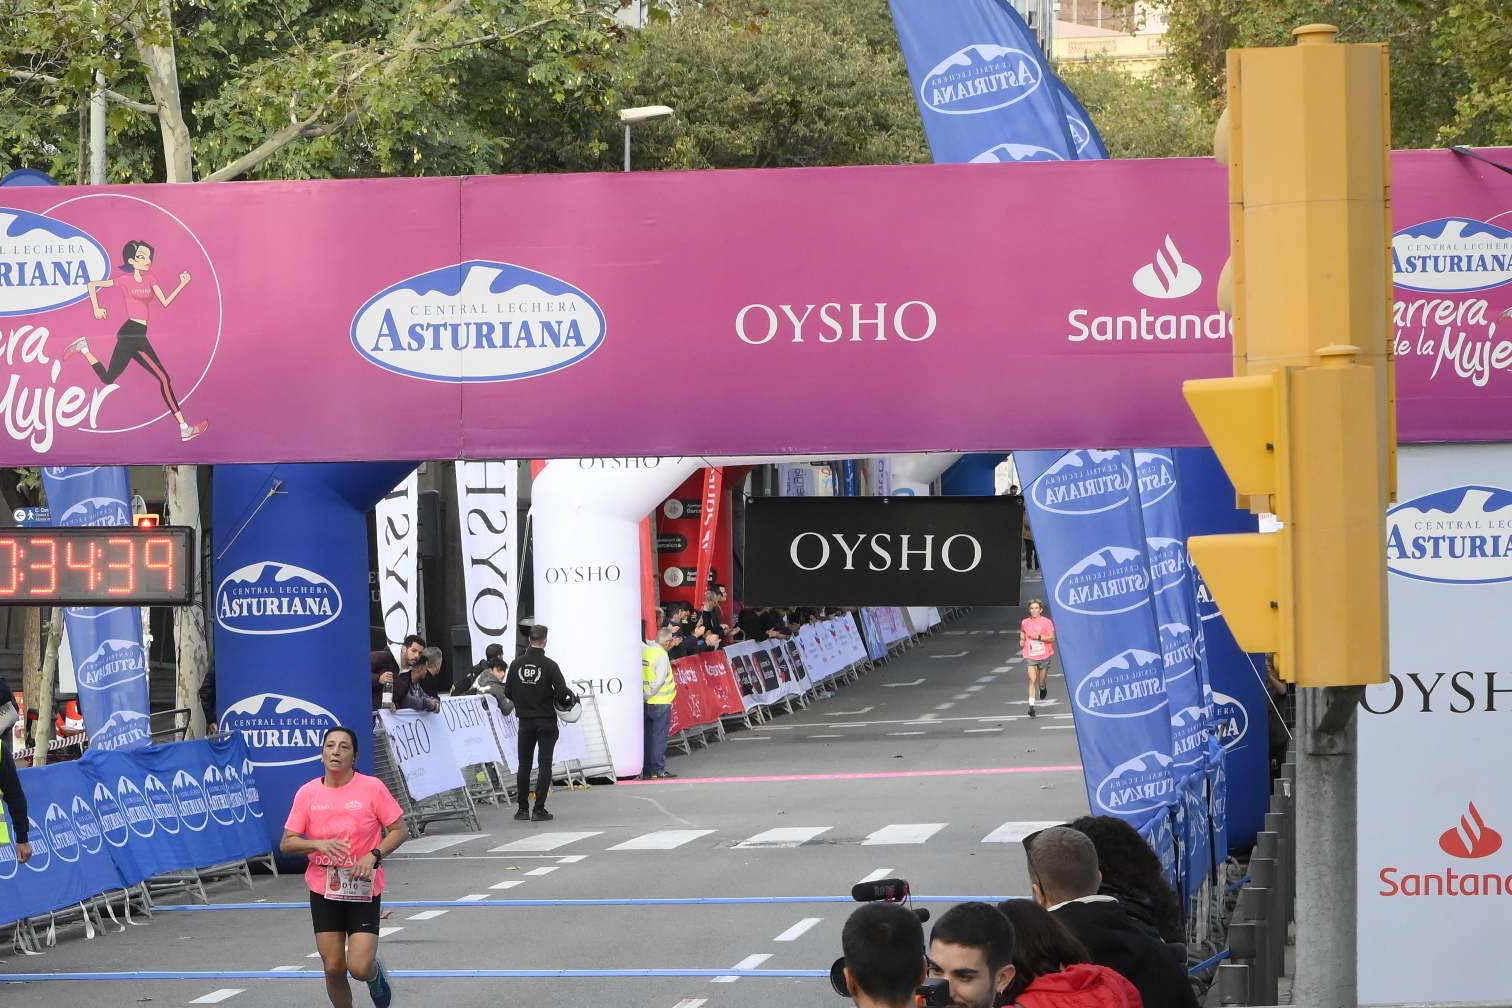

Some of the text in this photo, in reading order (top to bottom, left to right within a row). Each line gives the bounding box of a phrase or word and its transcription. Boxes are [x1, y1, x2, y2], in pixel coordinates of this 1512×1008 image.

[13, 243, 86, 257] LECHERA
[1406, 241, 1512, 251] CENTRAL LECHER
[409, 300, 578, 316] CENTRAL LECHERA
[1392, 298, 1489, 328] arrera
[370, 308, 587, 353] ASTURIANA
[734, 300, 938, 345] OYSHO
[1416, 328, 1435, 356] la
[1430, 321, 1512, 388] Muje
[1414, 520, 1482, 531] CENTRAL
[789, 531, 983, 573] OYSHO
[545, 564, 622, 585] OYSHO
[232, 586, 329, 595] CENTRAL LECHERA
[220, 591, 333, 619] ASTURIANA
[523, 668, 536, 678] BP
[575, 677, 623, 695] SHO
[234, 717, 329, 726] CENTRAL LECHERA
[233, 725, 328, 748] TURIAN
